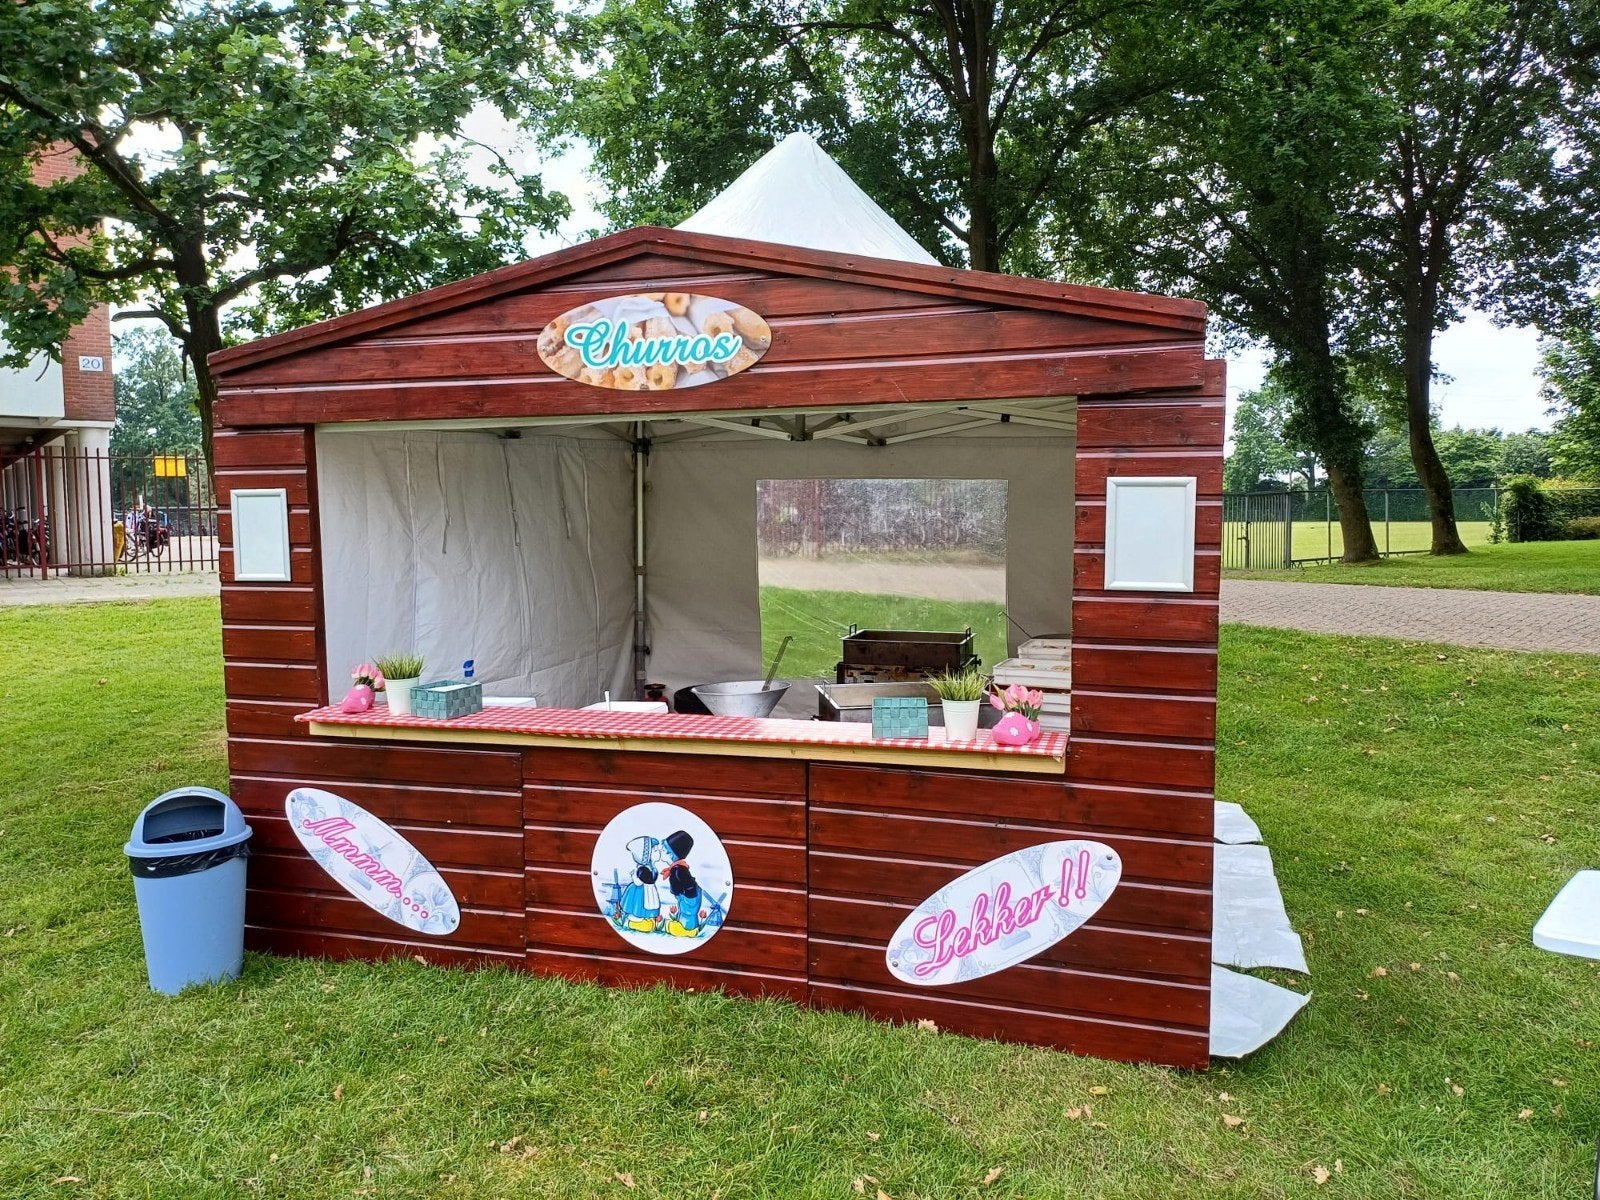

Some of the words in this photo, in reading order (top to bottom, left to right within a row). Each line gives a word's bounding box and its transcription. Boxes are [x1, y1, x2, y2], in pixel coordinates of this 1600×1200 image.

[82, 358, 101, 369] 20
[565, 318, 742, 369] Churros
[913, 849, 1090, 977] Lekker!!
